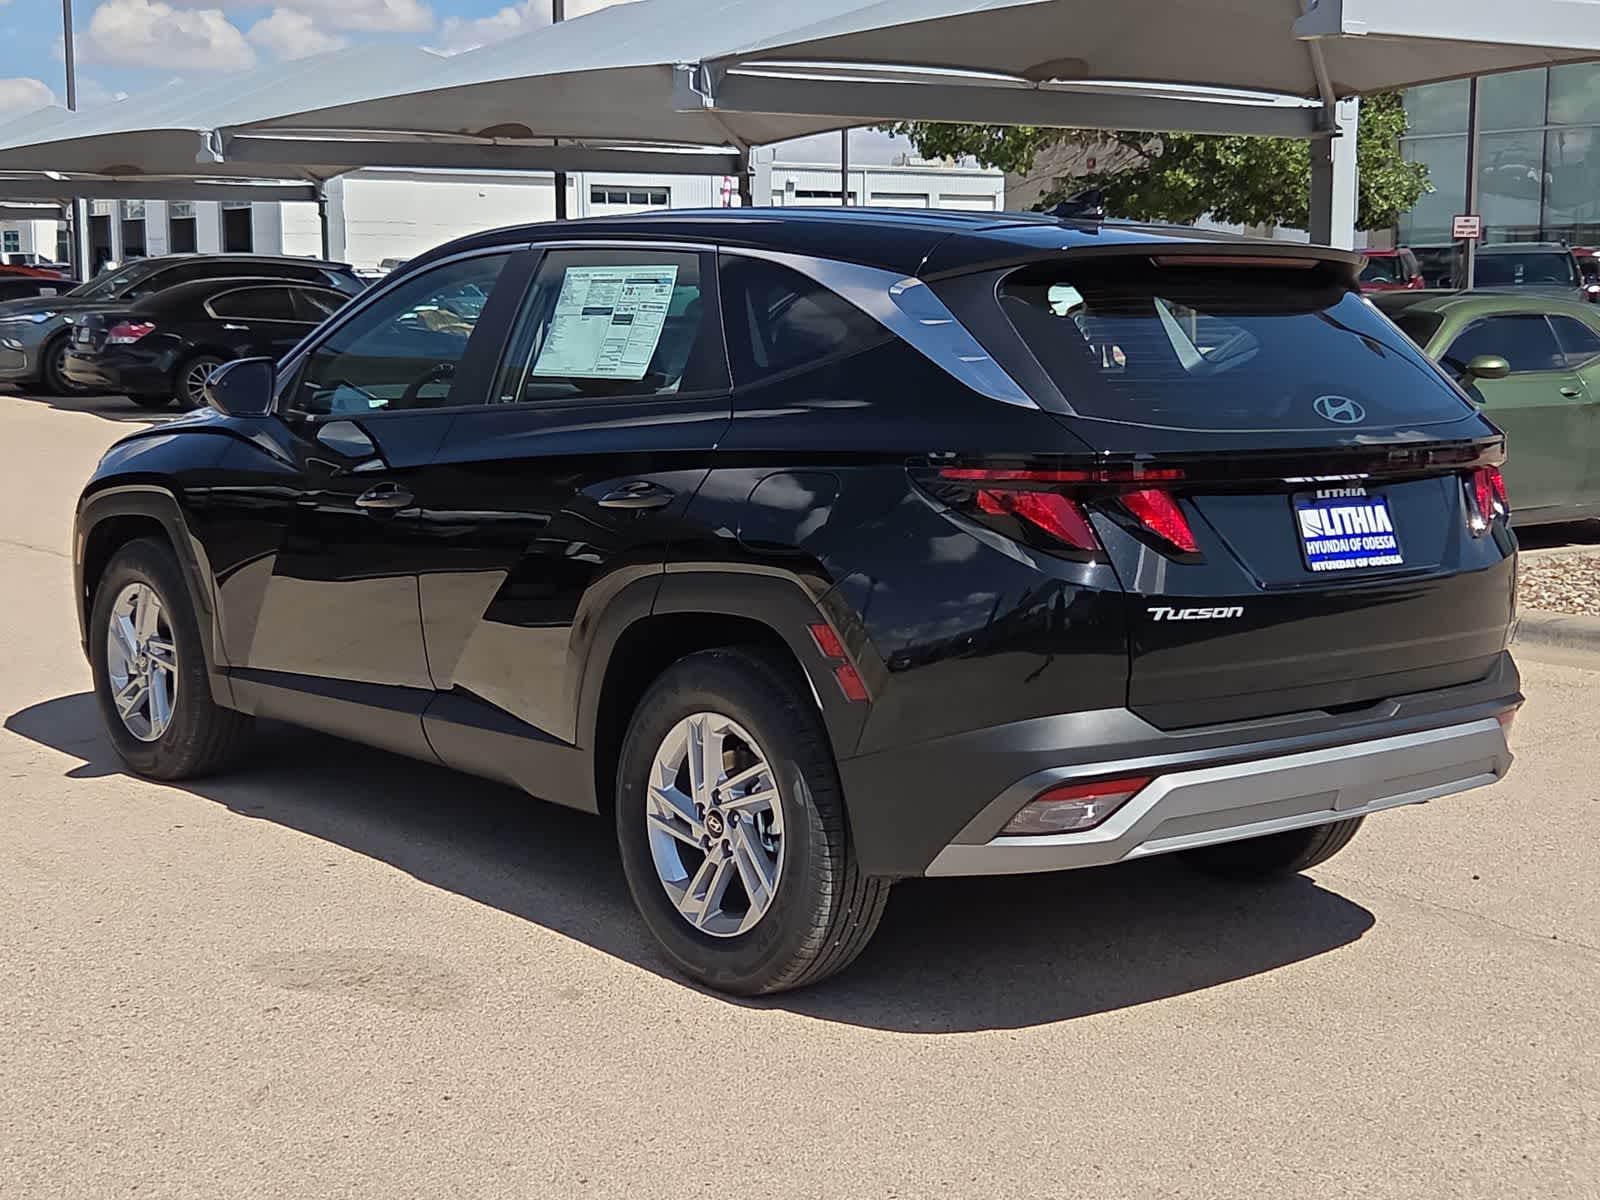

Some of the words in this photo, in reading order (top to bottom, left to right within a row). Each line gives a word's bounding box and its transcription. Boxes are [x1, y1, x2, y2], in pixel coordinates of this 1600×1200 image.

[1316, 488, 1367, 498] LITHIA
[1319, 505, 1393, 536] LITHIA
[1306, 539, 1349, 555] HYUNDAI
[1349, 537, 1362, 552] OF
[1362, 535, 1397, 550] ODESSA
[1311, 559, 1356, 571] HYUNDAI
[1356, 557, 1369, 567] OF
[1368, 554, 1404, 566] ODESSA
